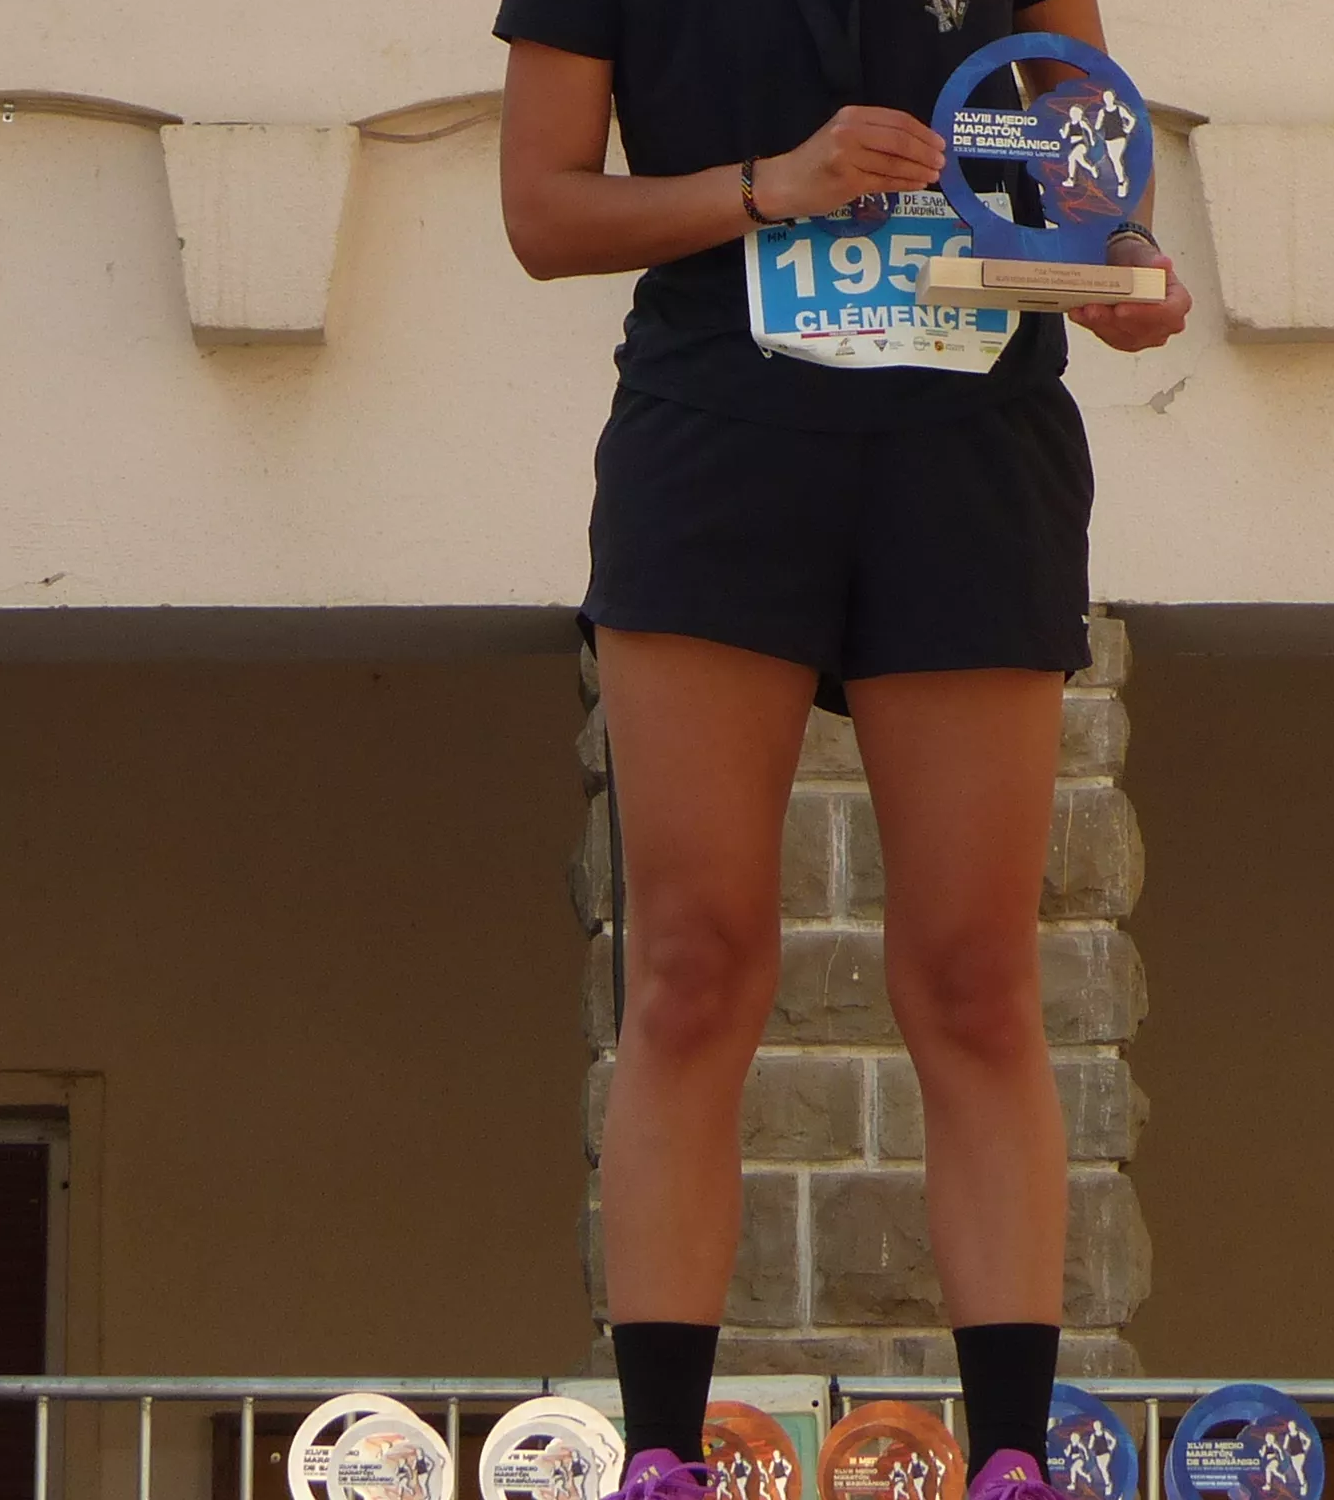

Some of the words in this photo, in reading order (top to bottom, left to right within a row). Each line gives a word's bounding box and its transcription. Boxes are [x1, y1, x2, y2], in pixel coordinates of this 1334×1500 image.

[954, 112, 992, 124] XLVIII
[995, 114, 1038, 126] MEDIO
[953, 123, 1021, 137] MARATÓN
[953, 135, 972, 145] DE
[976, 135, 1060, 150] SABIÑÁNIGO
[903, 194, 918, 206] DE
[921, 195, 949, 207] SABI
[795, 303, 978, 332] CLÉMENCE
